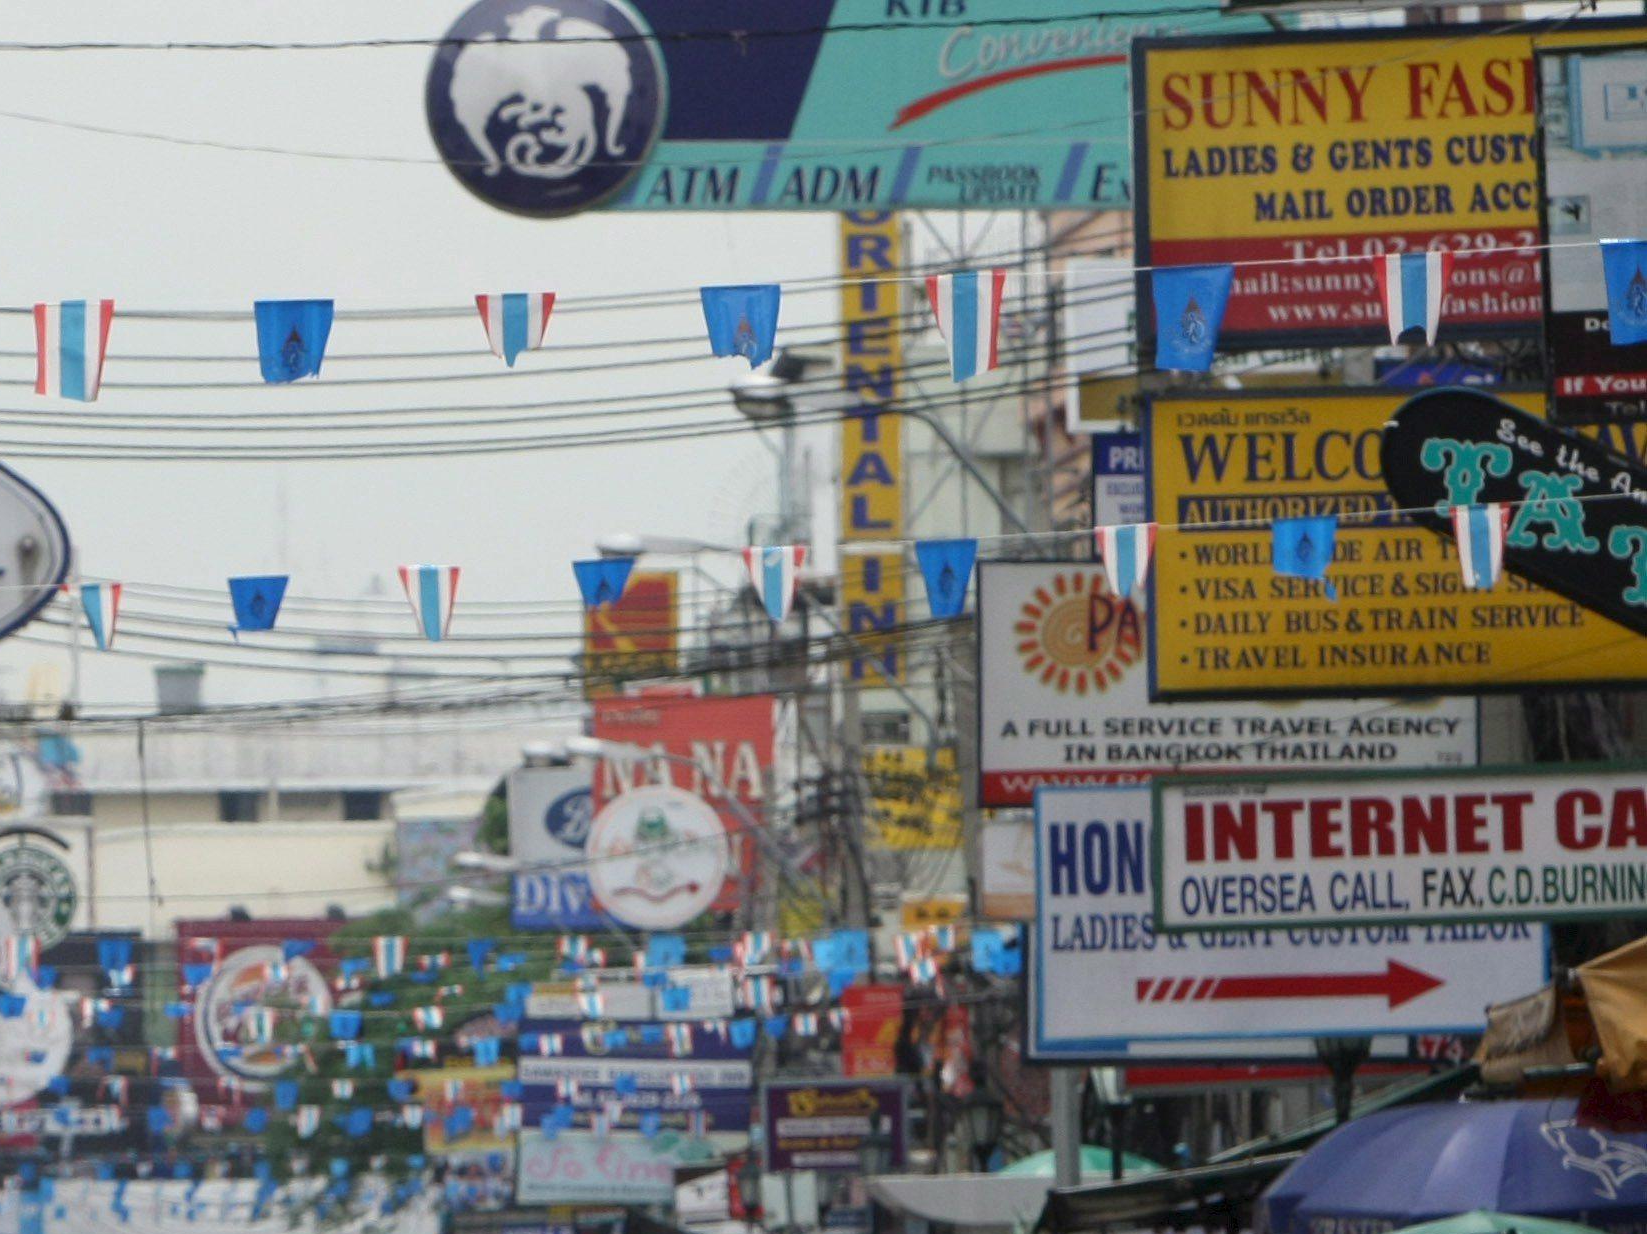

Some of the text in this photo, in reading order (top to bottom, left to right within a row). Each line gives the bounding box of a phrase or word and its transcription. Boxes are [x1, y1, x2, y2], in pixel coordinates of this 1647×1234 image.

[1162, 65, 1376, 131] SUNNY
[1164, 144, 1277, 178] LADIES
[1291, 143, 1315, 171] &
[1329, 138, 1433, 171] GENTS
[646, 163, 882, 203] ATM ADM
[1255, 179, 1540, 222] MAIL ORDER ACC
[1563, 377, 1583, 394] If
[1496, 418, 1544, 458] See
[1556, 443, 1600, 482] the
[1373, 536, 1424, 562] AIR
[1194, 574, 1258, 601] VISA
[1391, 571, 1410, 596] &
[1194, 602, 1585, 635] DAILY BUS & TRAIN SERVICE
[1195, 640, 1491, 670] TRAVEL INSURANCE
[1000, 716, 1461, 737] A FULL SERVICE TRAVEL AGENCY
[1064, 741, 1399, 763] IN BANGKOK THAILAND
[1184, 790, 1535, 864] INTERNET
[1181, 871, 1315, 916] OVERSEA
[1051, 912, 1155, 954] LADIES
